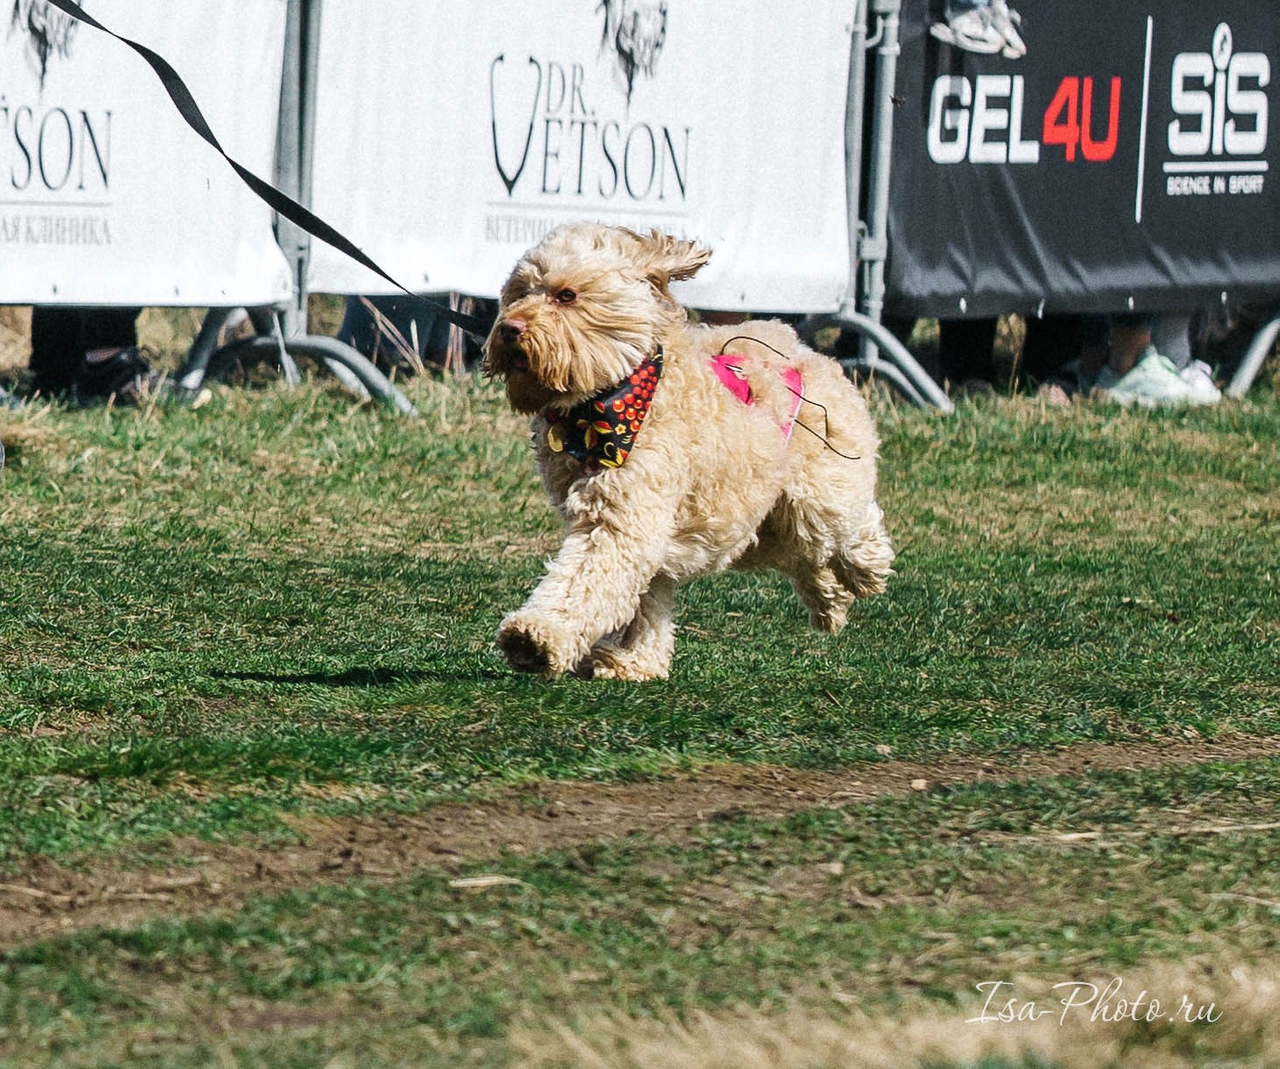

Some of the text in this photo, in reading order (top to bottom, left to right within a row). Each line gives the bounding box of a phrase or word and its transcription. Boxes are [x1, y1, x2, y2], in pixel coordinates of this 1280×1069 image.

[546, 61, 596, 117] DR.
[1213, 176, 1226, 194] IN
[1229, 174, 1264, 194] SPORT
